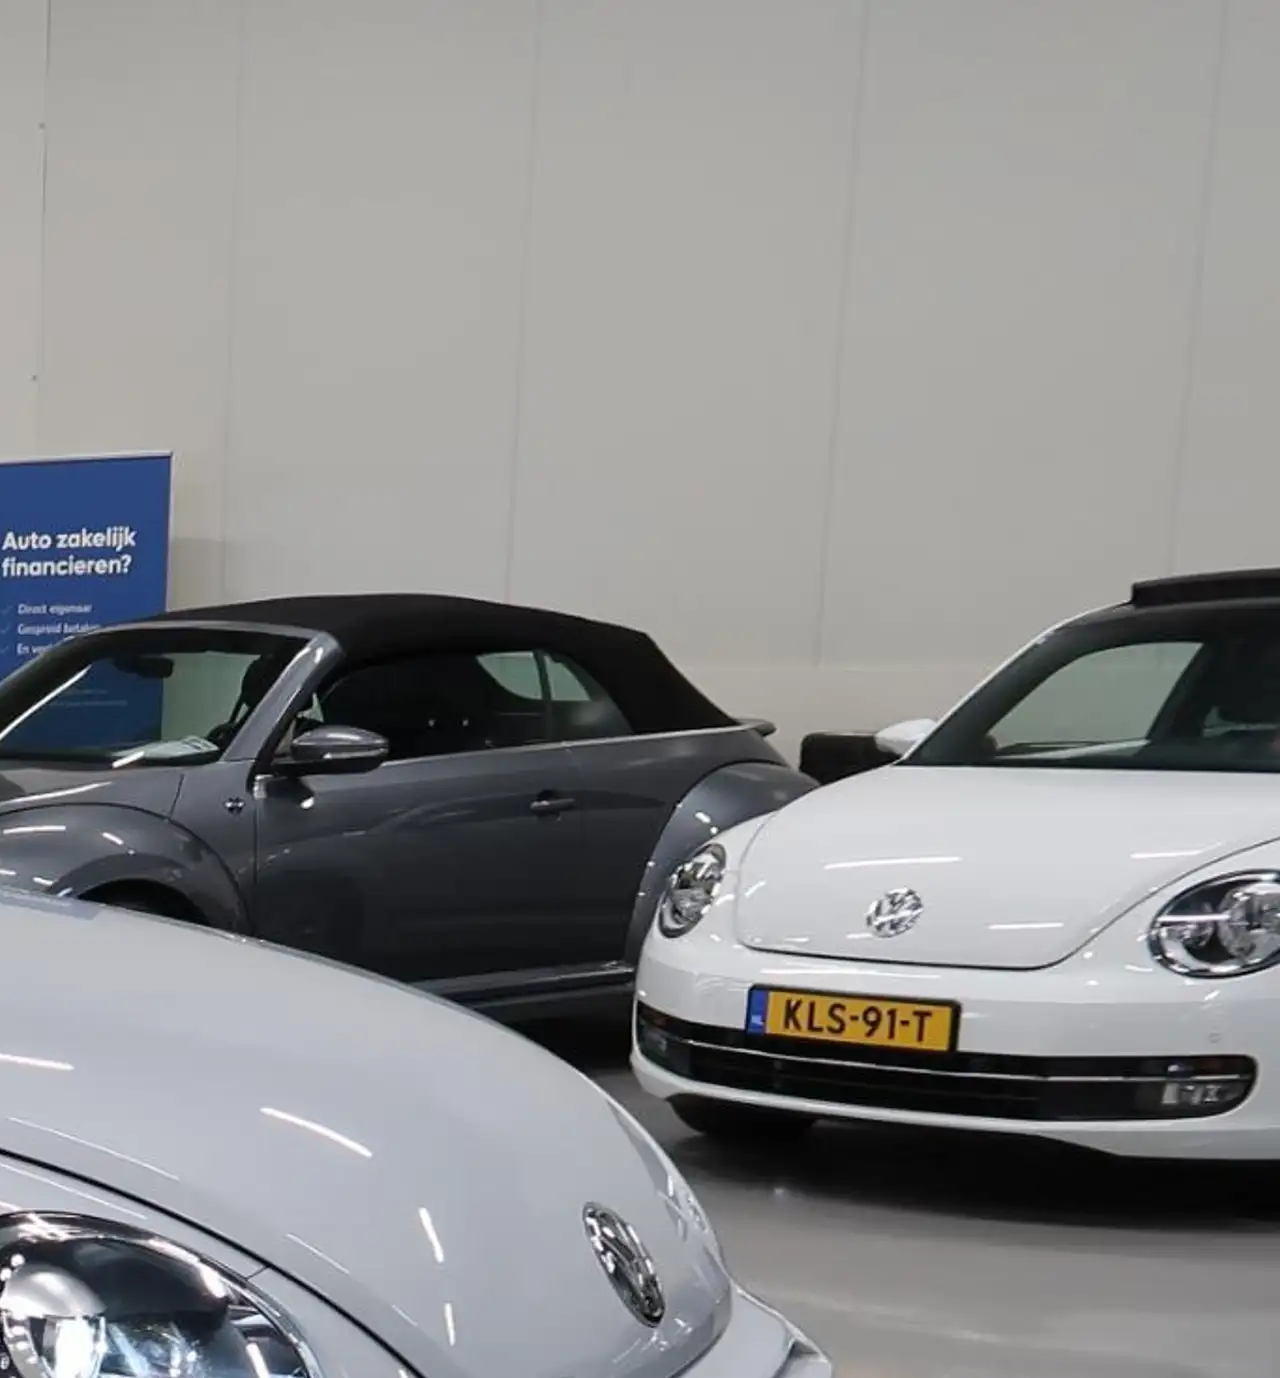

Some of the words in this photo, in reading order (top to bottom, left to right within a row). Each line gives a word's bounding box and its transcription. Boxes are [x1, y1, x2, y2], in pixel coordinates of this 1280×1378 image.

[2, 531, 52, 551] Auto
[56, 526, 137, 552] zakelijk
[1, 554, 132, 577] financieren?
[782, 998, 933, 1043] KLS-91-T
